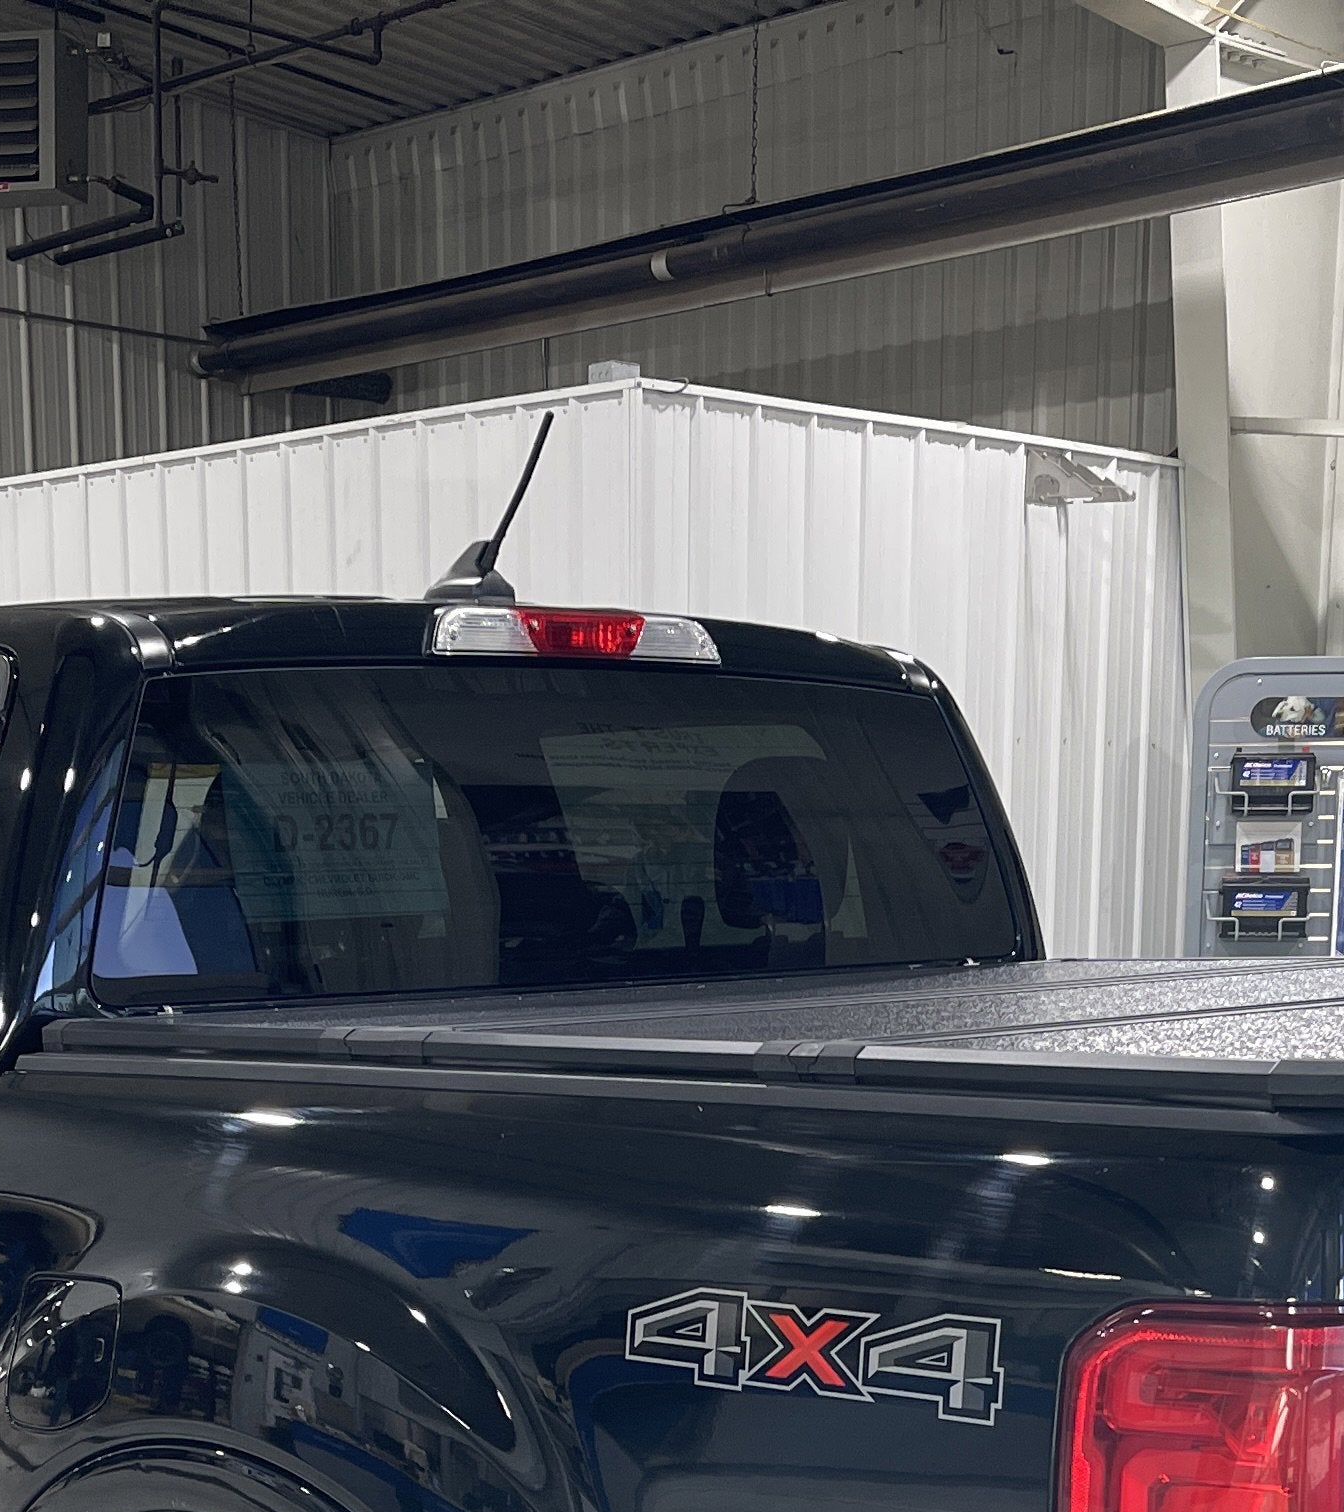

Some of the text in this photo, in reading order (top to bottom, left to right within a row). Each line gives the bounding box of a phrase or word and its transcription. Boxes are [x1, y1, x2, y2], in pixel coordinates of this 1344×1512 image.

[1266, 724, 1326, 736] BATTERIES
[330, 770, 382, 786] DAKOA
[338, 791, 388, 804] DEALER
[273, 812, 399, 853] D-2367
